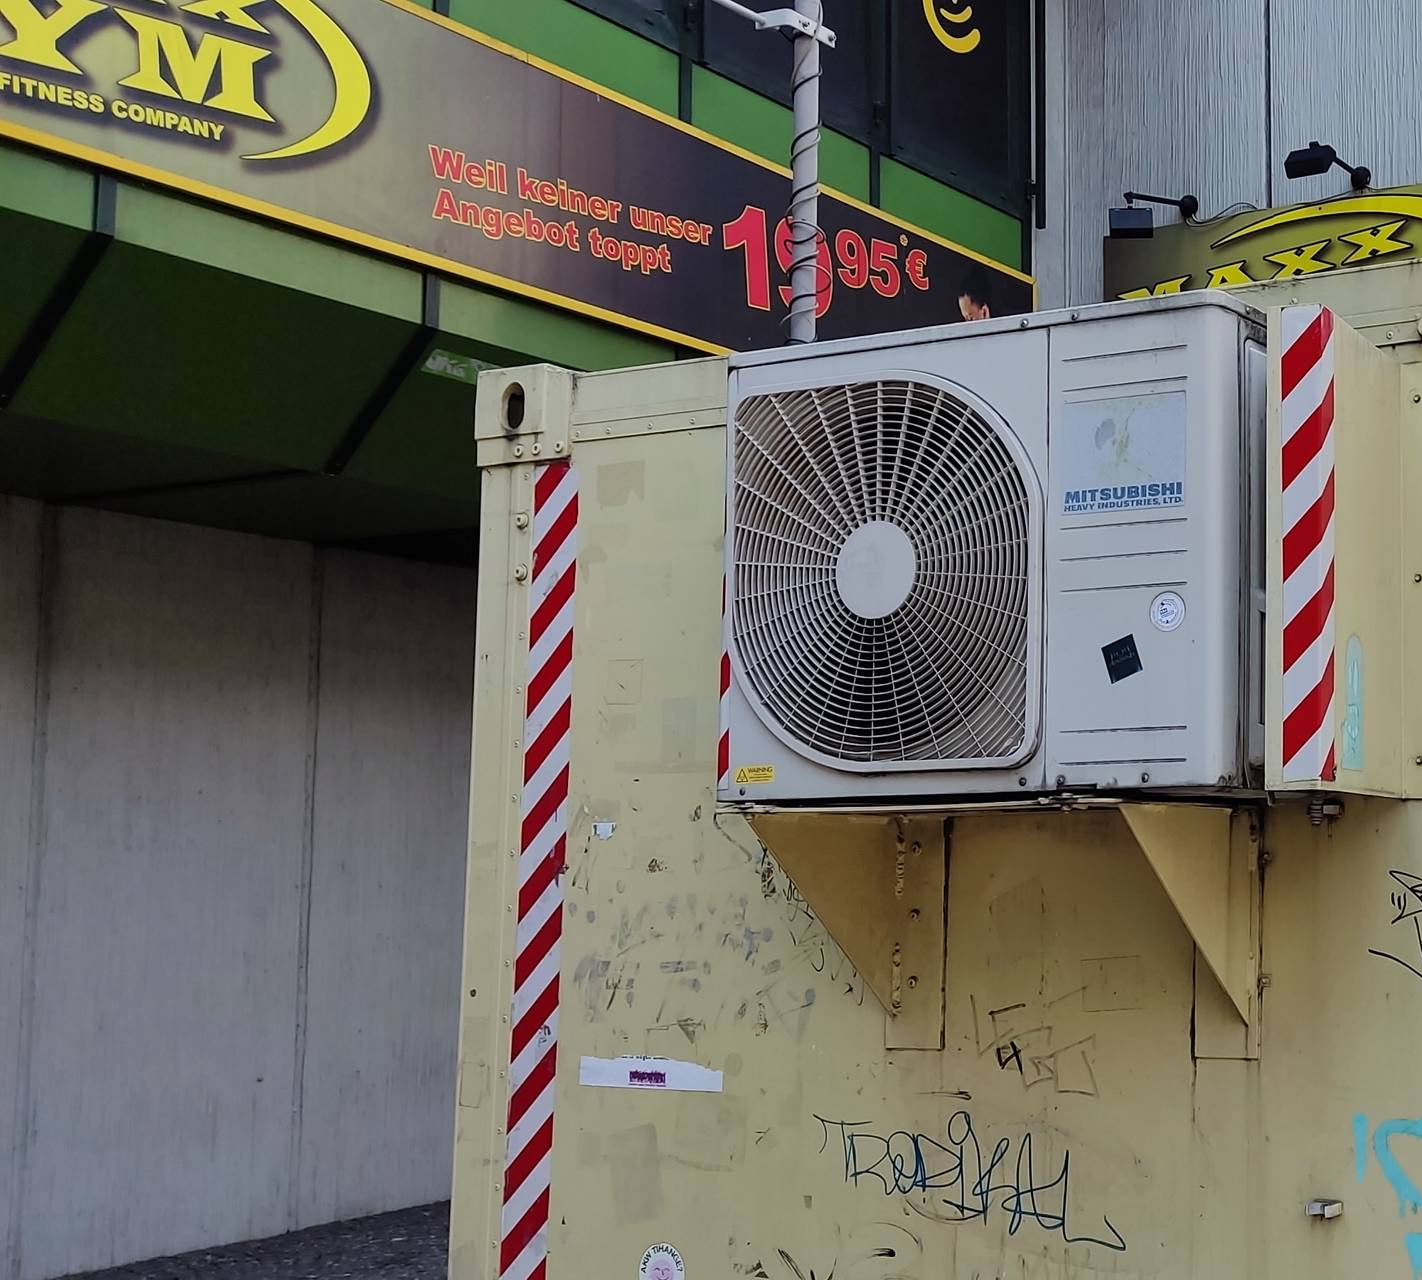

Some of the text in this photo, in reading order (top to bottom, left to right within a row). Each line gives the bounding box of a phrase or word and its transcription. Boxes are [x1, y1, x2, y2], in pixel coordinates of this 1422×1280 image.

[0, 72, 225, 141] FITNESS COMPANY
[429, 144, 713, 245] Weil keiner unser
[432, 188, 672, 275] Angebot toppt
[1064, 482, 1183, 504] MITSUBISHI
[1064, 503, 1095, 512] HEAVY
[1098, 497, 1161, 510] INDUSTRIES,
